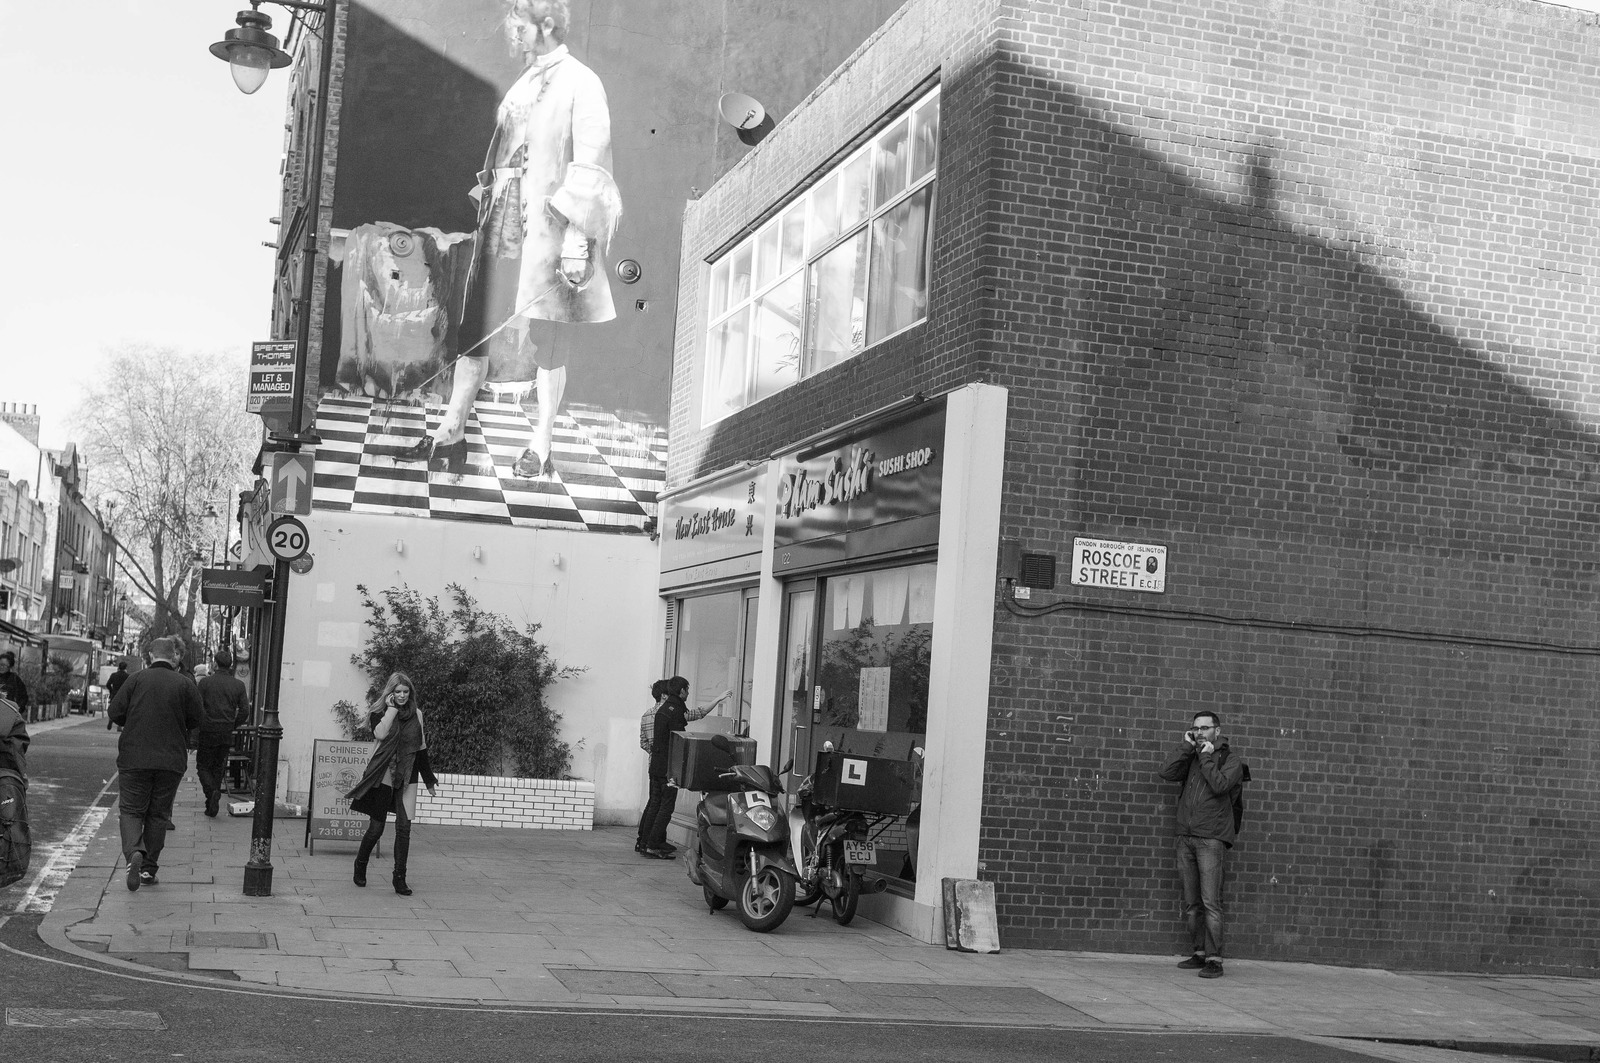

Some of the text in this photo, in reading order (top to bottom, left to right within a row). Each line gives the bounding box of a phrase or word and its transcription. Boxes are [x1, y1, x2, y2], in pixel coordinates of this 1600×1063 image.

[254, 344, 295, 352] SPENCER
[262, 373, 282, 382] LET &
[252, 382, 290, 392] MANAGED
[878, 447, 931, 478] SUSHI SHOP
[675, 507, 736, 540] New East House
[274, 531, 304, 550] 20
[1075, 540, 1097, 548] LONDON
[1099, 542, 1125, 550] BOROUGH
[1136, 546, 1165, 554] ISLINGTON
[1081, 549, 1141, 570] ROSCOE
[1080, 567, 1139, 587] STREET
[329, 746, 368, 755] CHINESE
[318, 755, 371, 765] RESTAURA
[848, 764, 861, 780] L
[335, 797, 352, 806] FRE
[752, 793, 765, 803] L
[343, 820, 362, 828] 020
[318, 827, 367, 837] 7336 883
[845, 841, 874, 851] AY58
[849, 851, 871, 861] ECJ
